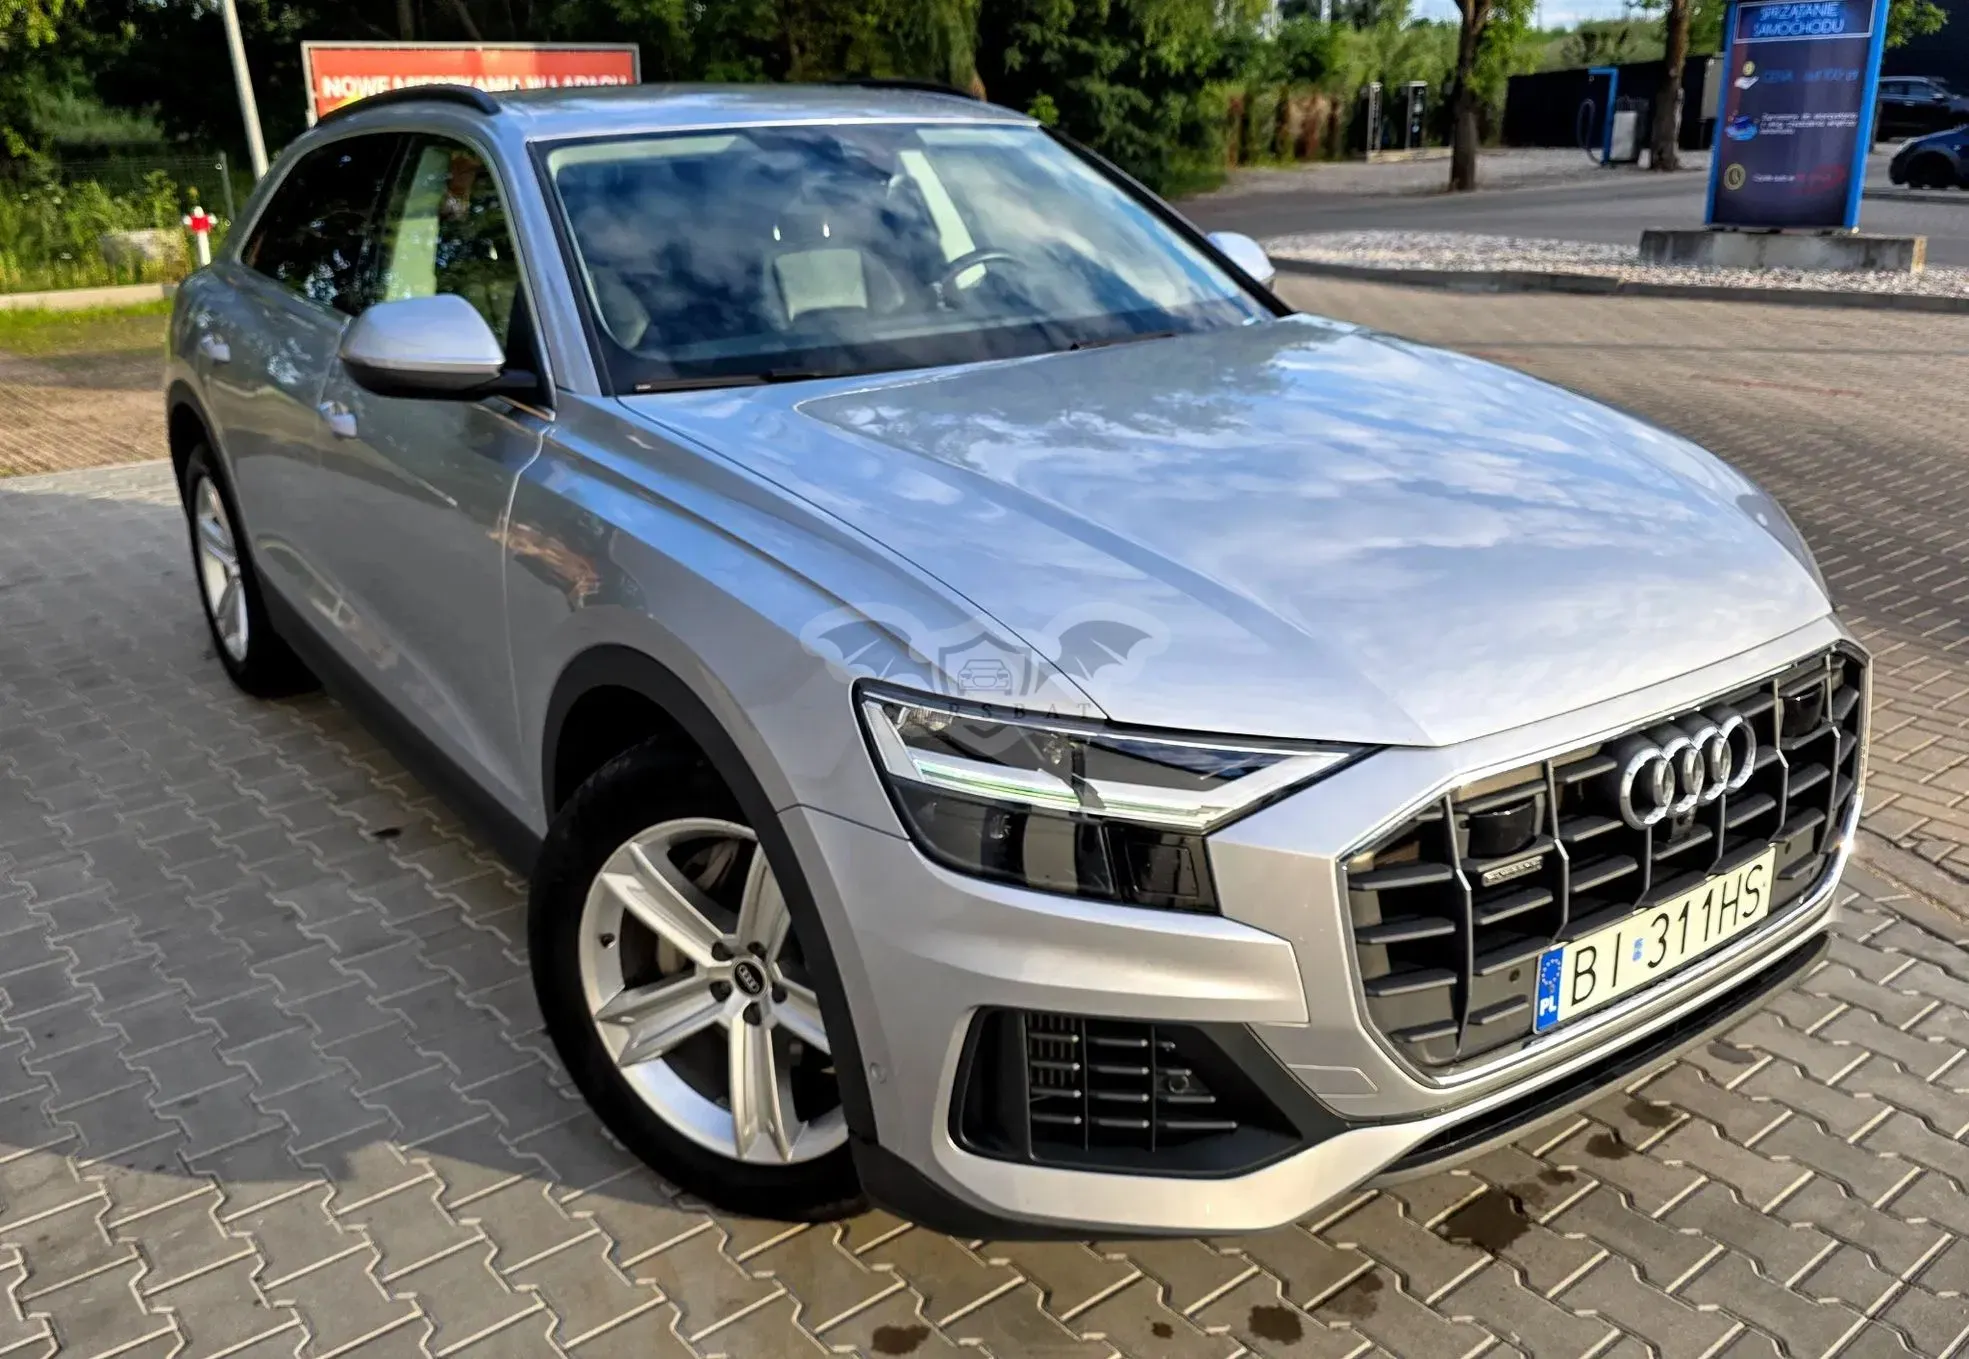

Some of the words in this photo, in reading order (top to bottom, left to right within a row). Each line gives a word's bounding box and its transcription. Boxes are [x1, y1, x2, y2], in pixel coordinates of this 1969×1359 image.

[1753, 18, 1845, 36] SAMOCHODU
[1647, 864, 1763, 968] 311HS
[1540, 995, 1557, 1016] PL
